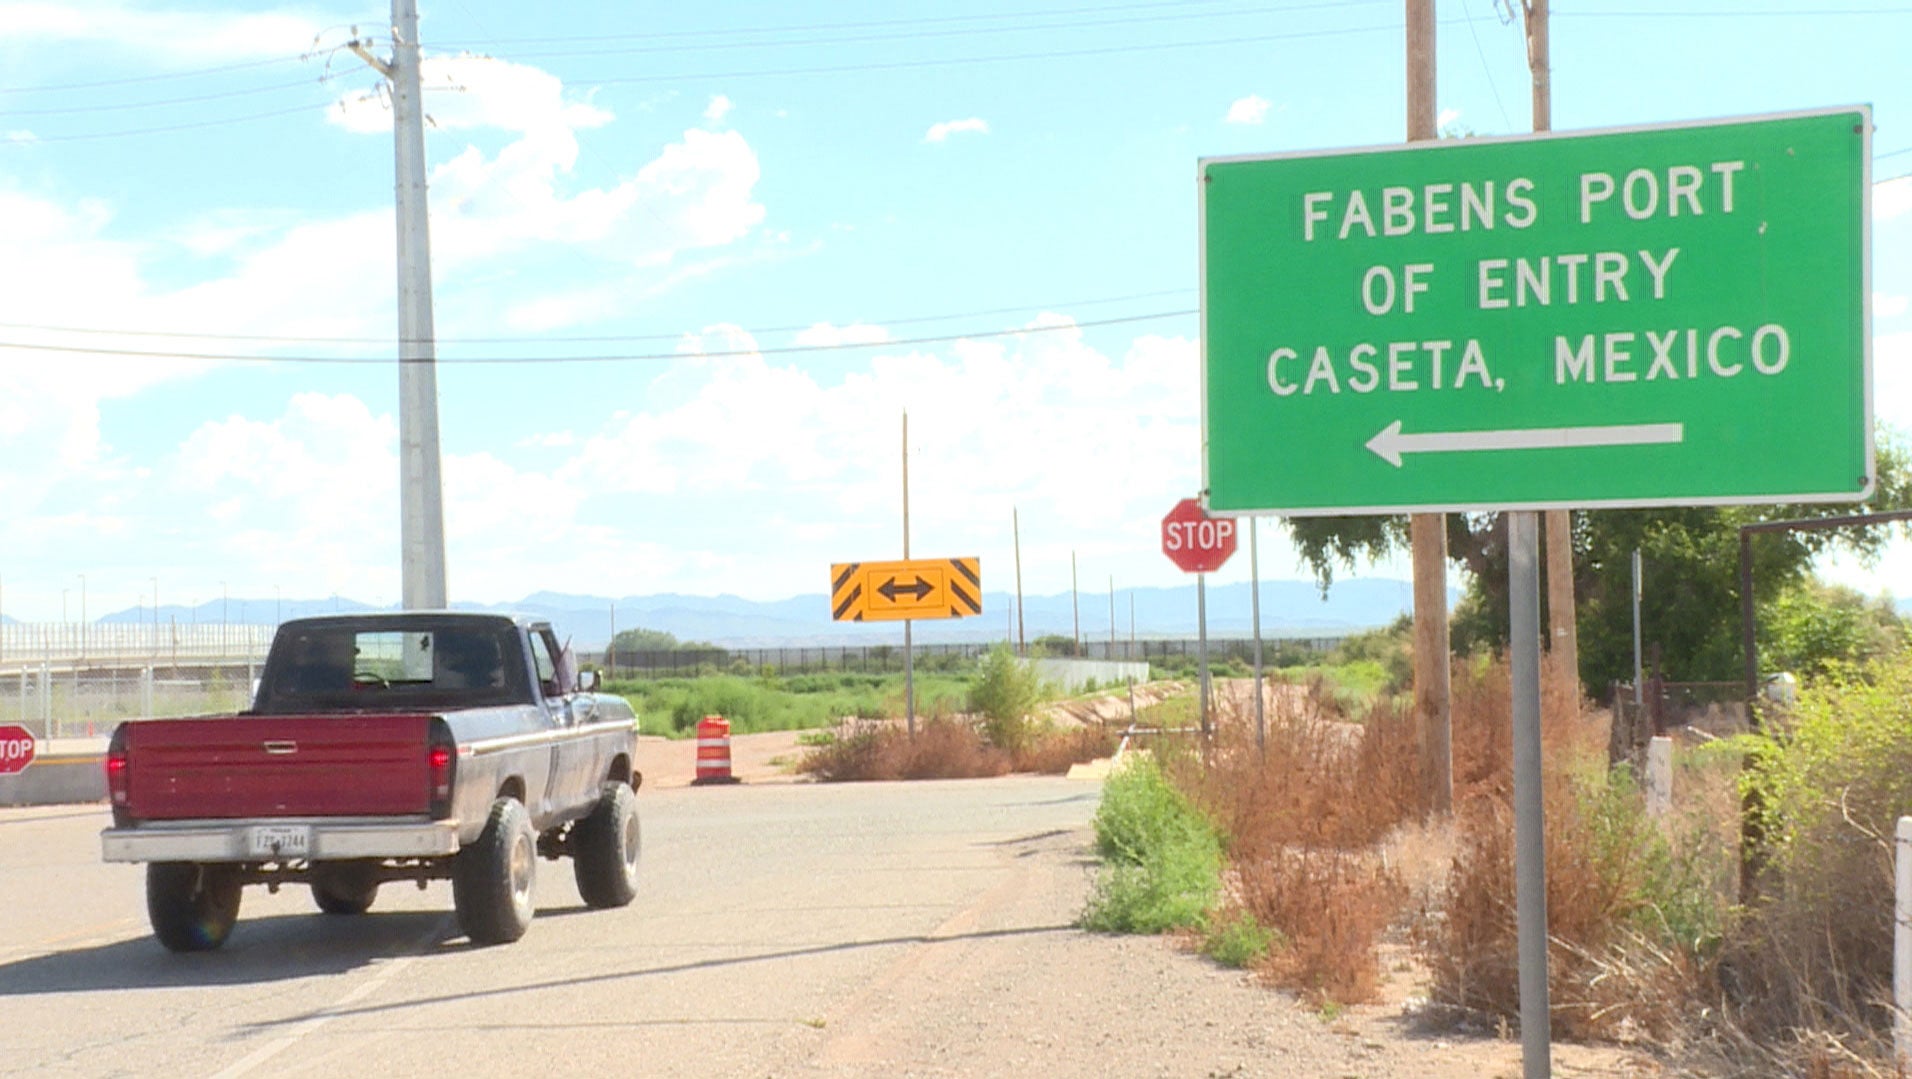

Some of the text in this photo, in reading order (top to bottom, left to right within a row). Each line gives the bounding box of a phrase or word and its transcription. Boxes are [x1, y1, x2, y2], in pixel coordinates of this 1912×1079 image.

[1303, 161, 1745, 241] FABENS PORT
[1361, 248, 1680, 316] OF ENTRY
[1266, 324, 1791, 396] CASETA, MEXICO
[1166, 520, 1233, 551] STOP
[0, 739, 33, 759] TOP
